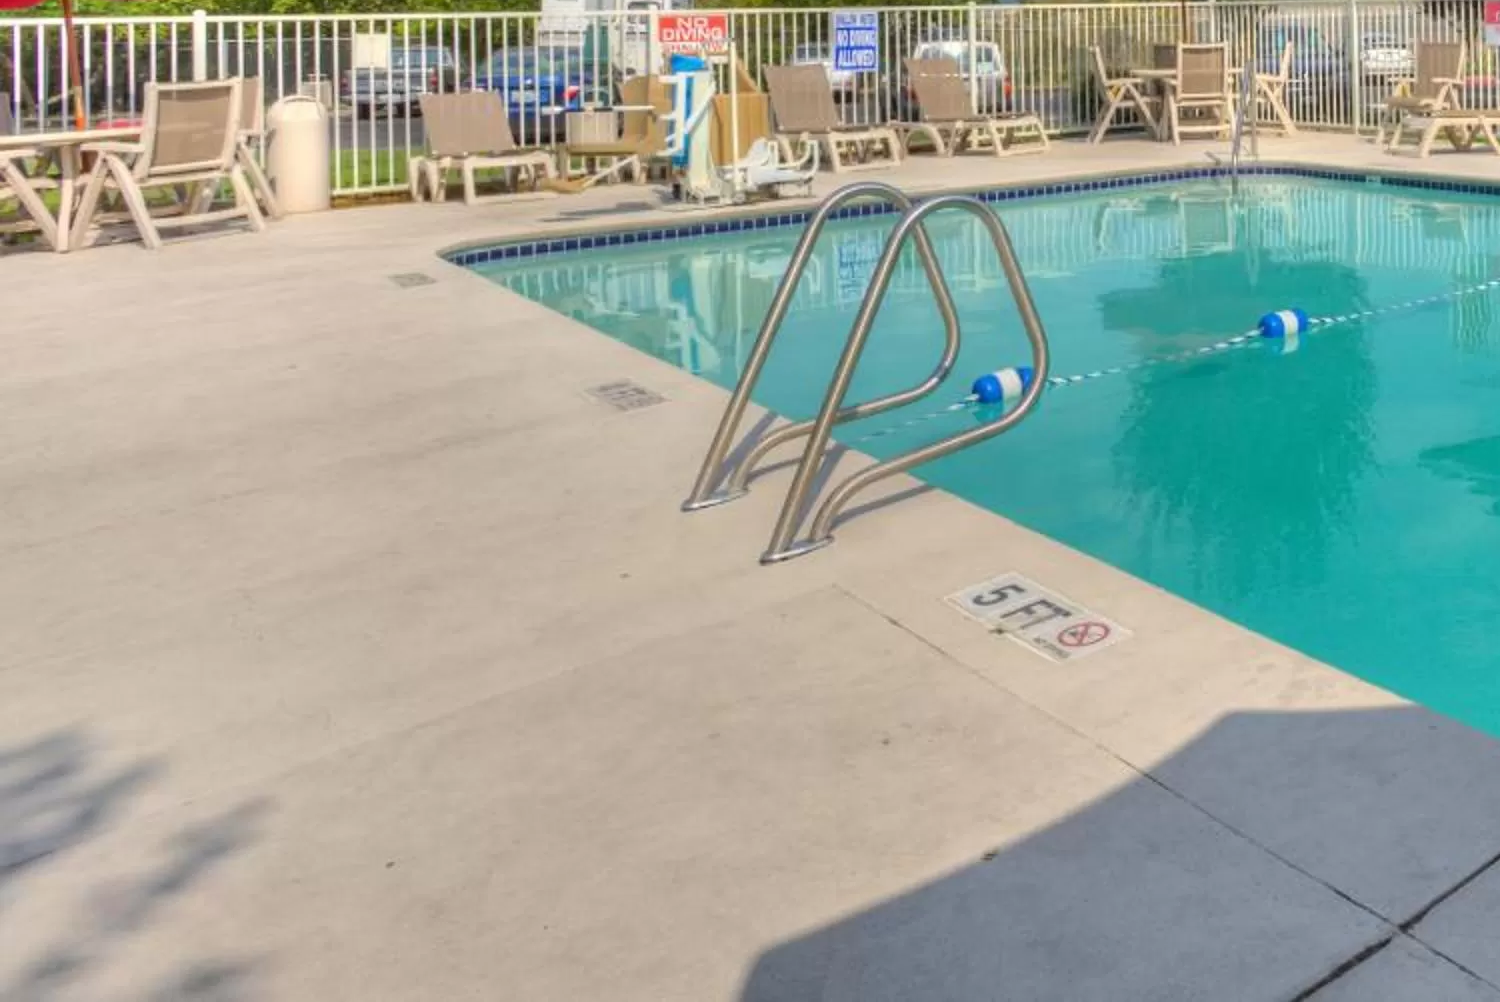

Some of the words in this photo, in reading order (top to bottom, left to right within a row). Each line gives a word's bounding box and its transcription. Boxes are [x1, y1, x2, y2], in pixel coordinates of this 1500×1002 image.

[677, 17, 709, 29] NO
[662, 27, 723, 41] DIVING
[838, 49, 874, 66] ALLOWED
[973, 584, 1026, 606] 5
[1001, 599, 1072, 630] FT
